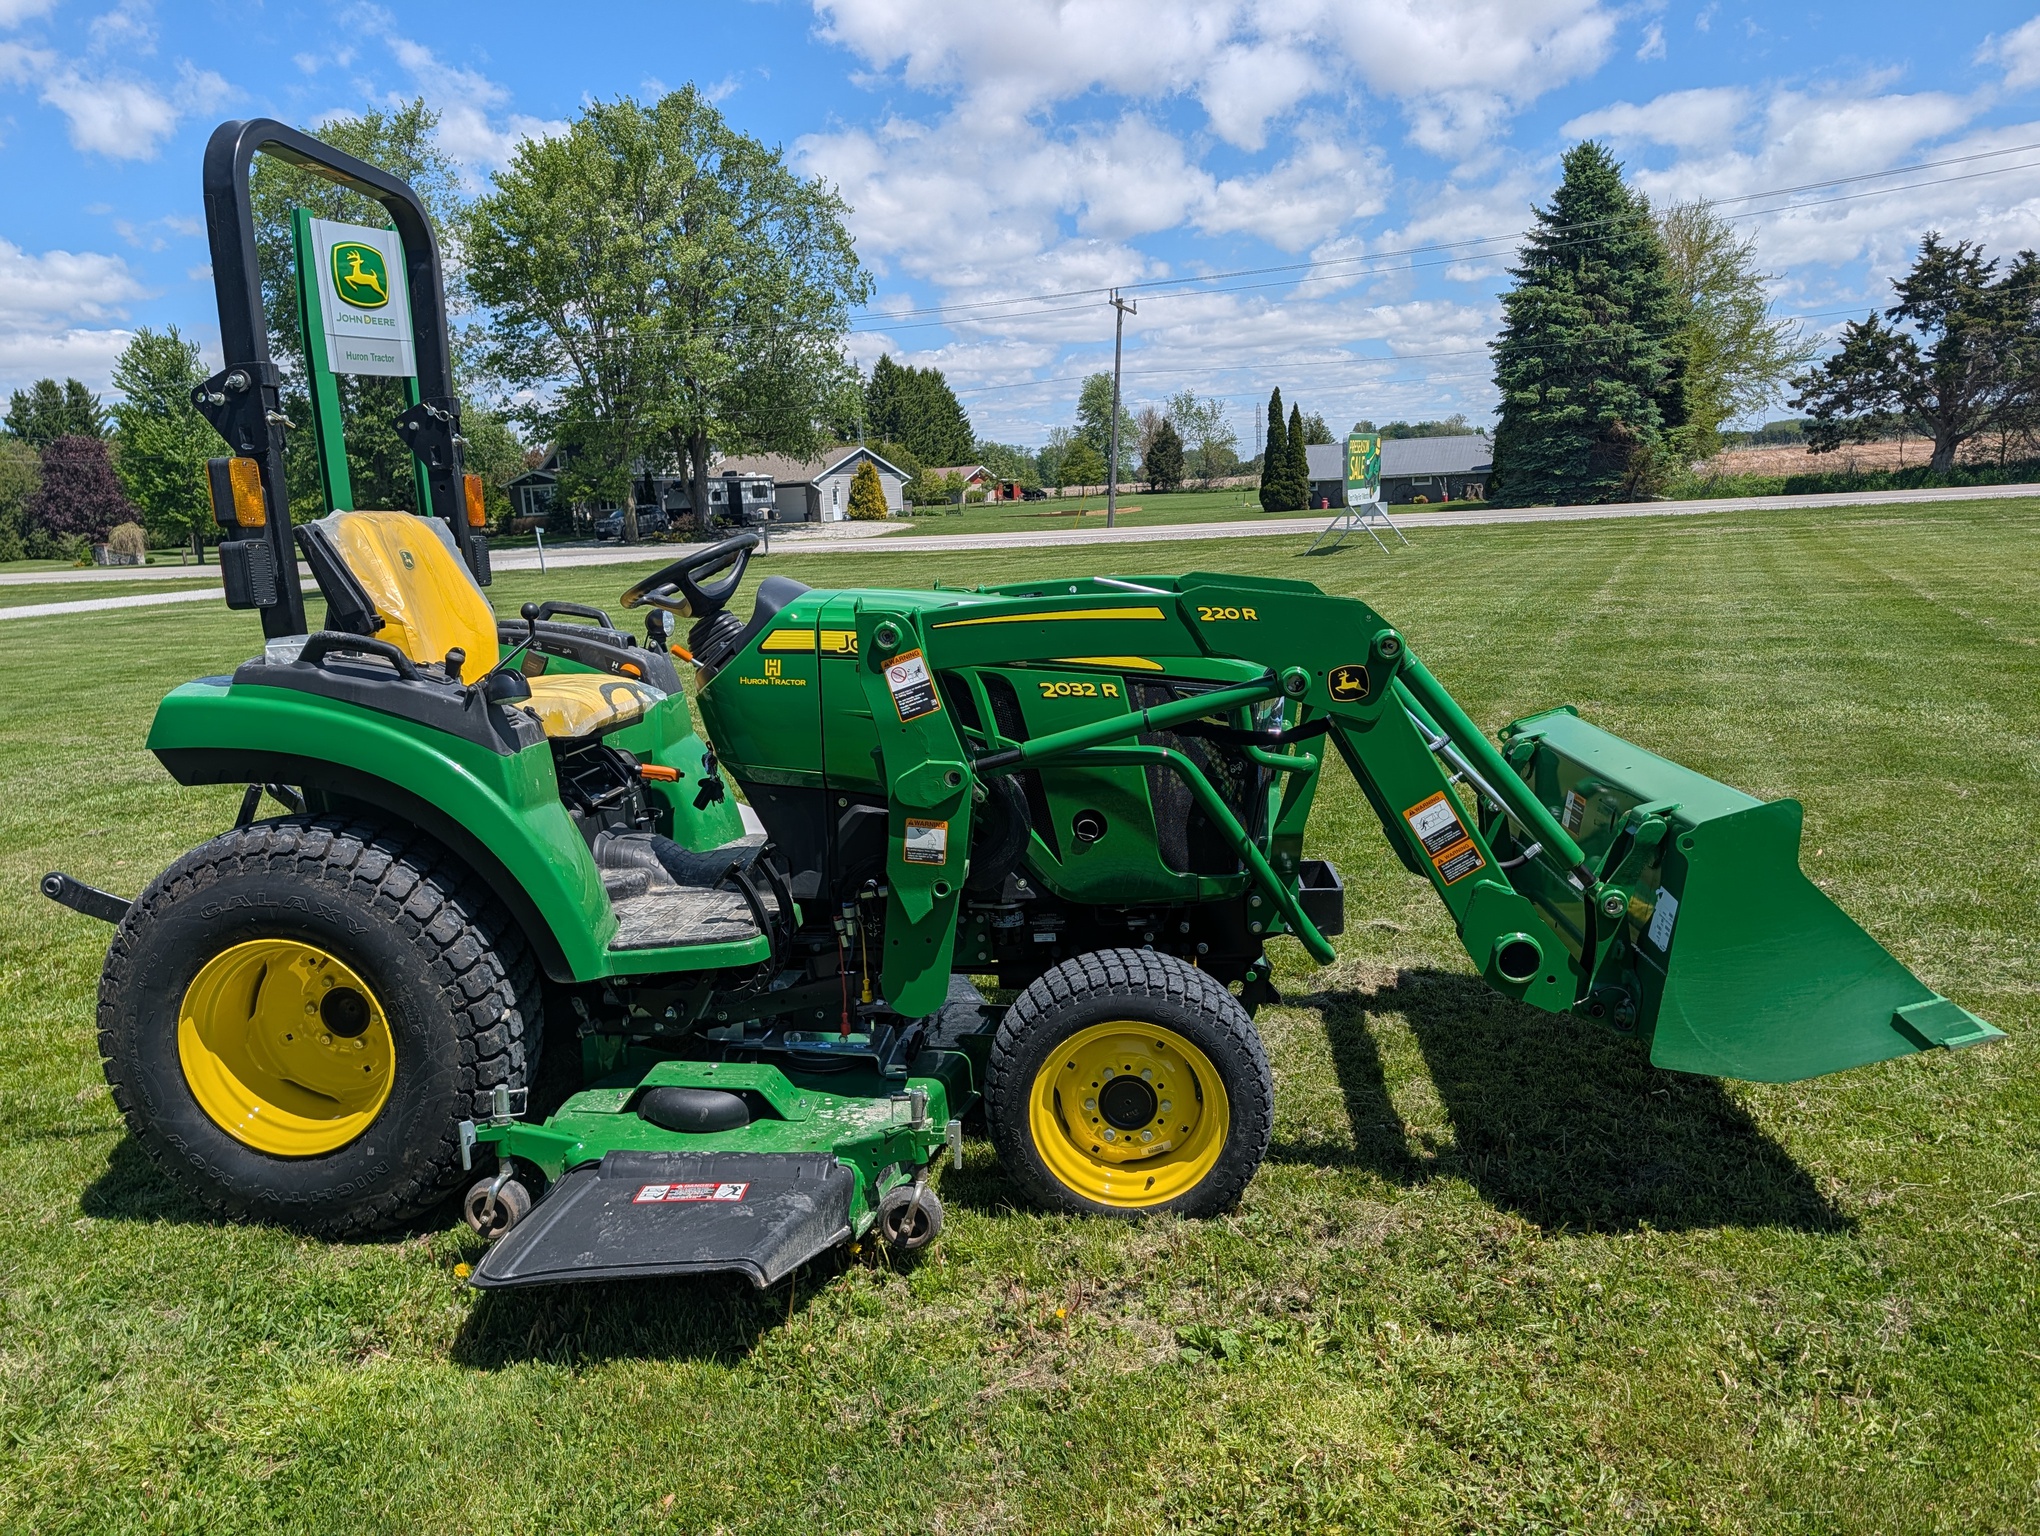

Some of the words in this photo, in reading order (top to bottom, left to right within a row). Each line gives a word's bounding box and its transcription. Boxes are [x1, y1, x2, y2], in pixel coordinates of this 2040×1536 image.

[336, 312, 363, 324] JOHN
[363, 314, 396, 327] DEERE
[345, 351, 369, 361] Huron
[370, 352, 395, 363] Tractor
[1349, 455, 1365, 480] SALE
[1196, 606, 1240, 622] 220
[1241, 607, 1259, 622] R
[889, 650, 920, 666] WARNING
[739, 676, 769, 685] HURON
[769, 677, 807, 686] TRACTOR
[1038, 682, 1098, 698] 2032
[1101, 683, 1120, 699] R
[1415, 796, 1440, 812] WARNING
[914, 820, 946, 828] WARNING
[1444, 843, 1470, 860] WARNING
[200, 892, 370, 935] GALAXY
[166, 1133, 234, 1187] MOW
[258, 1160, 390, 1203] MIGHTY
